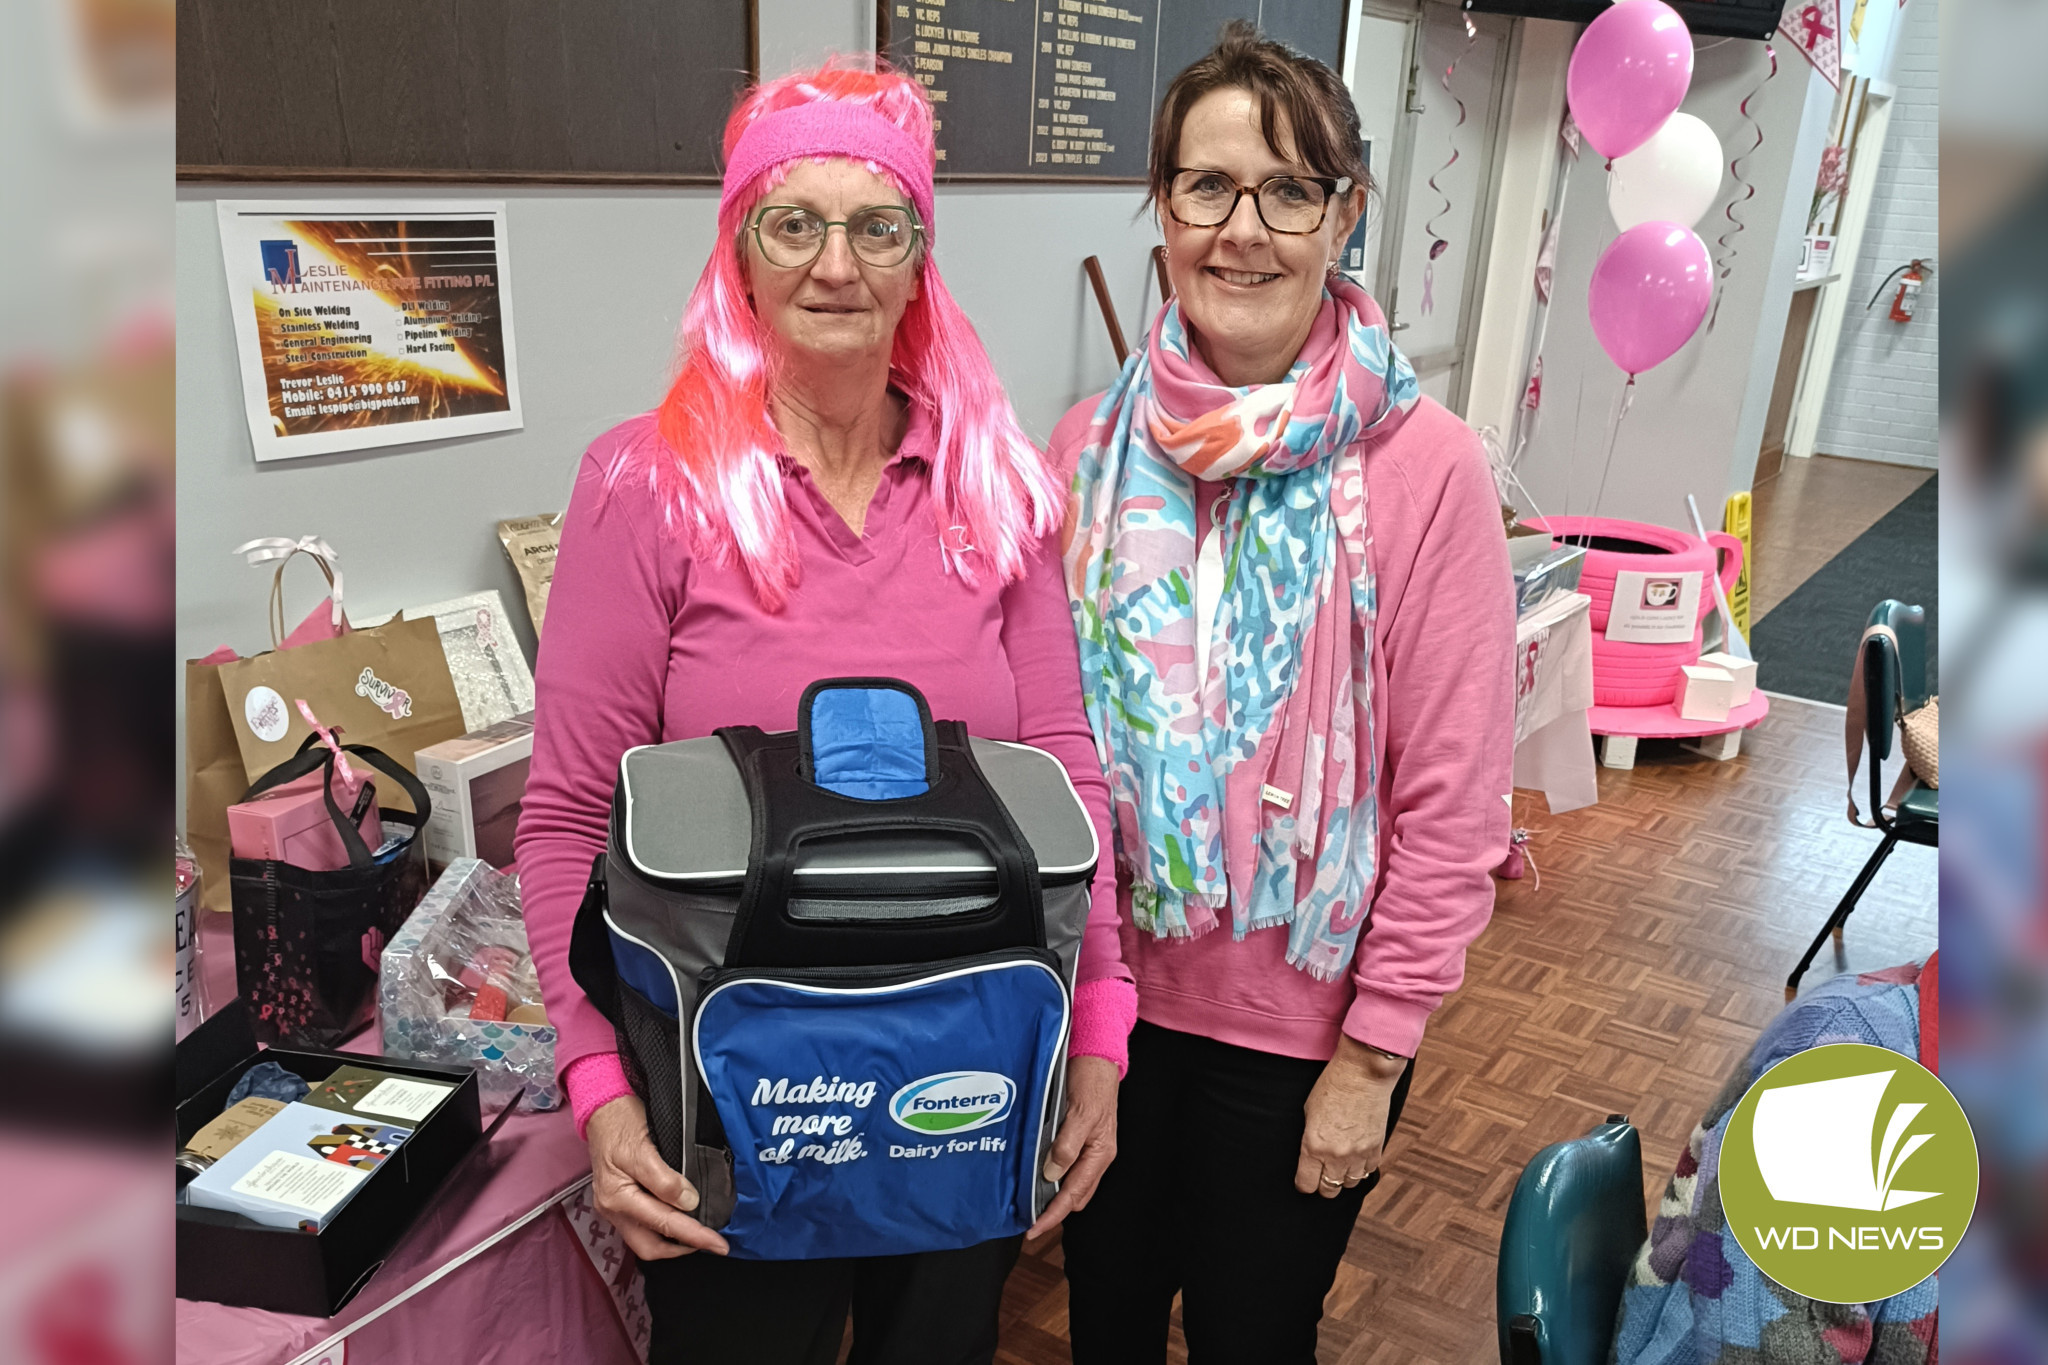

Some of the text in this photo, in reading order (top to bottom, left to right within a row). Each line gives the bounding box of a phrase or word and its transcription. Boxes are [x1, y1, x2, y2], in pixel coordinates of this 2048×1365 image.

[926, 9, 941, 23] REPS
[953, 29, 980, 44] WILTSHIRE
[932, 43, 951, 56] JUNIOR
[951, 45, 966, 58] GIRLS
[967, 47, 987, 61] SINGLES
[920, 57, 944, 71] PEARSON
[285, 249, 348, 277] LESLIE
[268, 268, 494, 294] MAINTENANCE PIPE FITTING P/L
[279, 305, 350, 317] On Site Welding
[417, 300, 450, 312] Welding
[281, 320, 359, 333] Stainless Welding
[404, 313, 481, 325] Aluminium Welding
[283, 334, 372, 348] General Engineering
[405, 327, 472, 341] Pipeline Welding
[406, 342, 455, 353] Hard Facing
[285, 349, 367, 362] Steel Construction
[280, 374, 344, 389] Trevor Leslie
[282, 380, 406, 403] Mobile: 0414 990 667
[284, 395, 419, 418] Email: lespipe@bigpond.com
[751, 1076, 877, 1108] Making
[913, 1092, 1001, 1110] Fonterra
[772, 1115, 853, 1136] more
[759, 1135, 868, 1164] of milk.
[889, 1144, 943, 1159] Dairy
[946, 1139, 978, 1153] for
